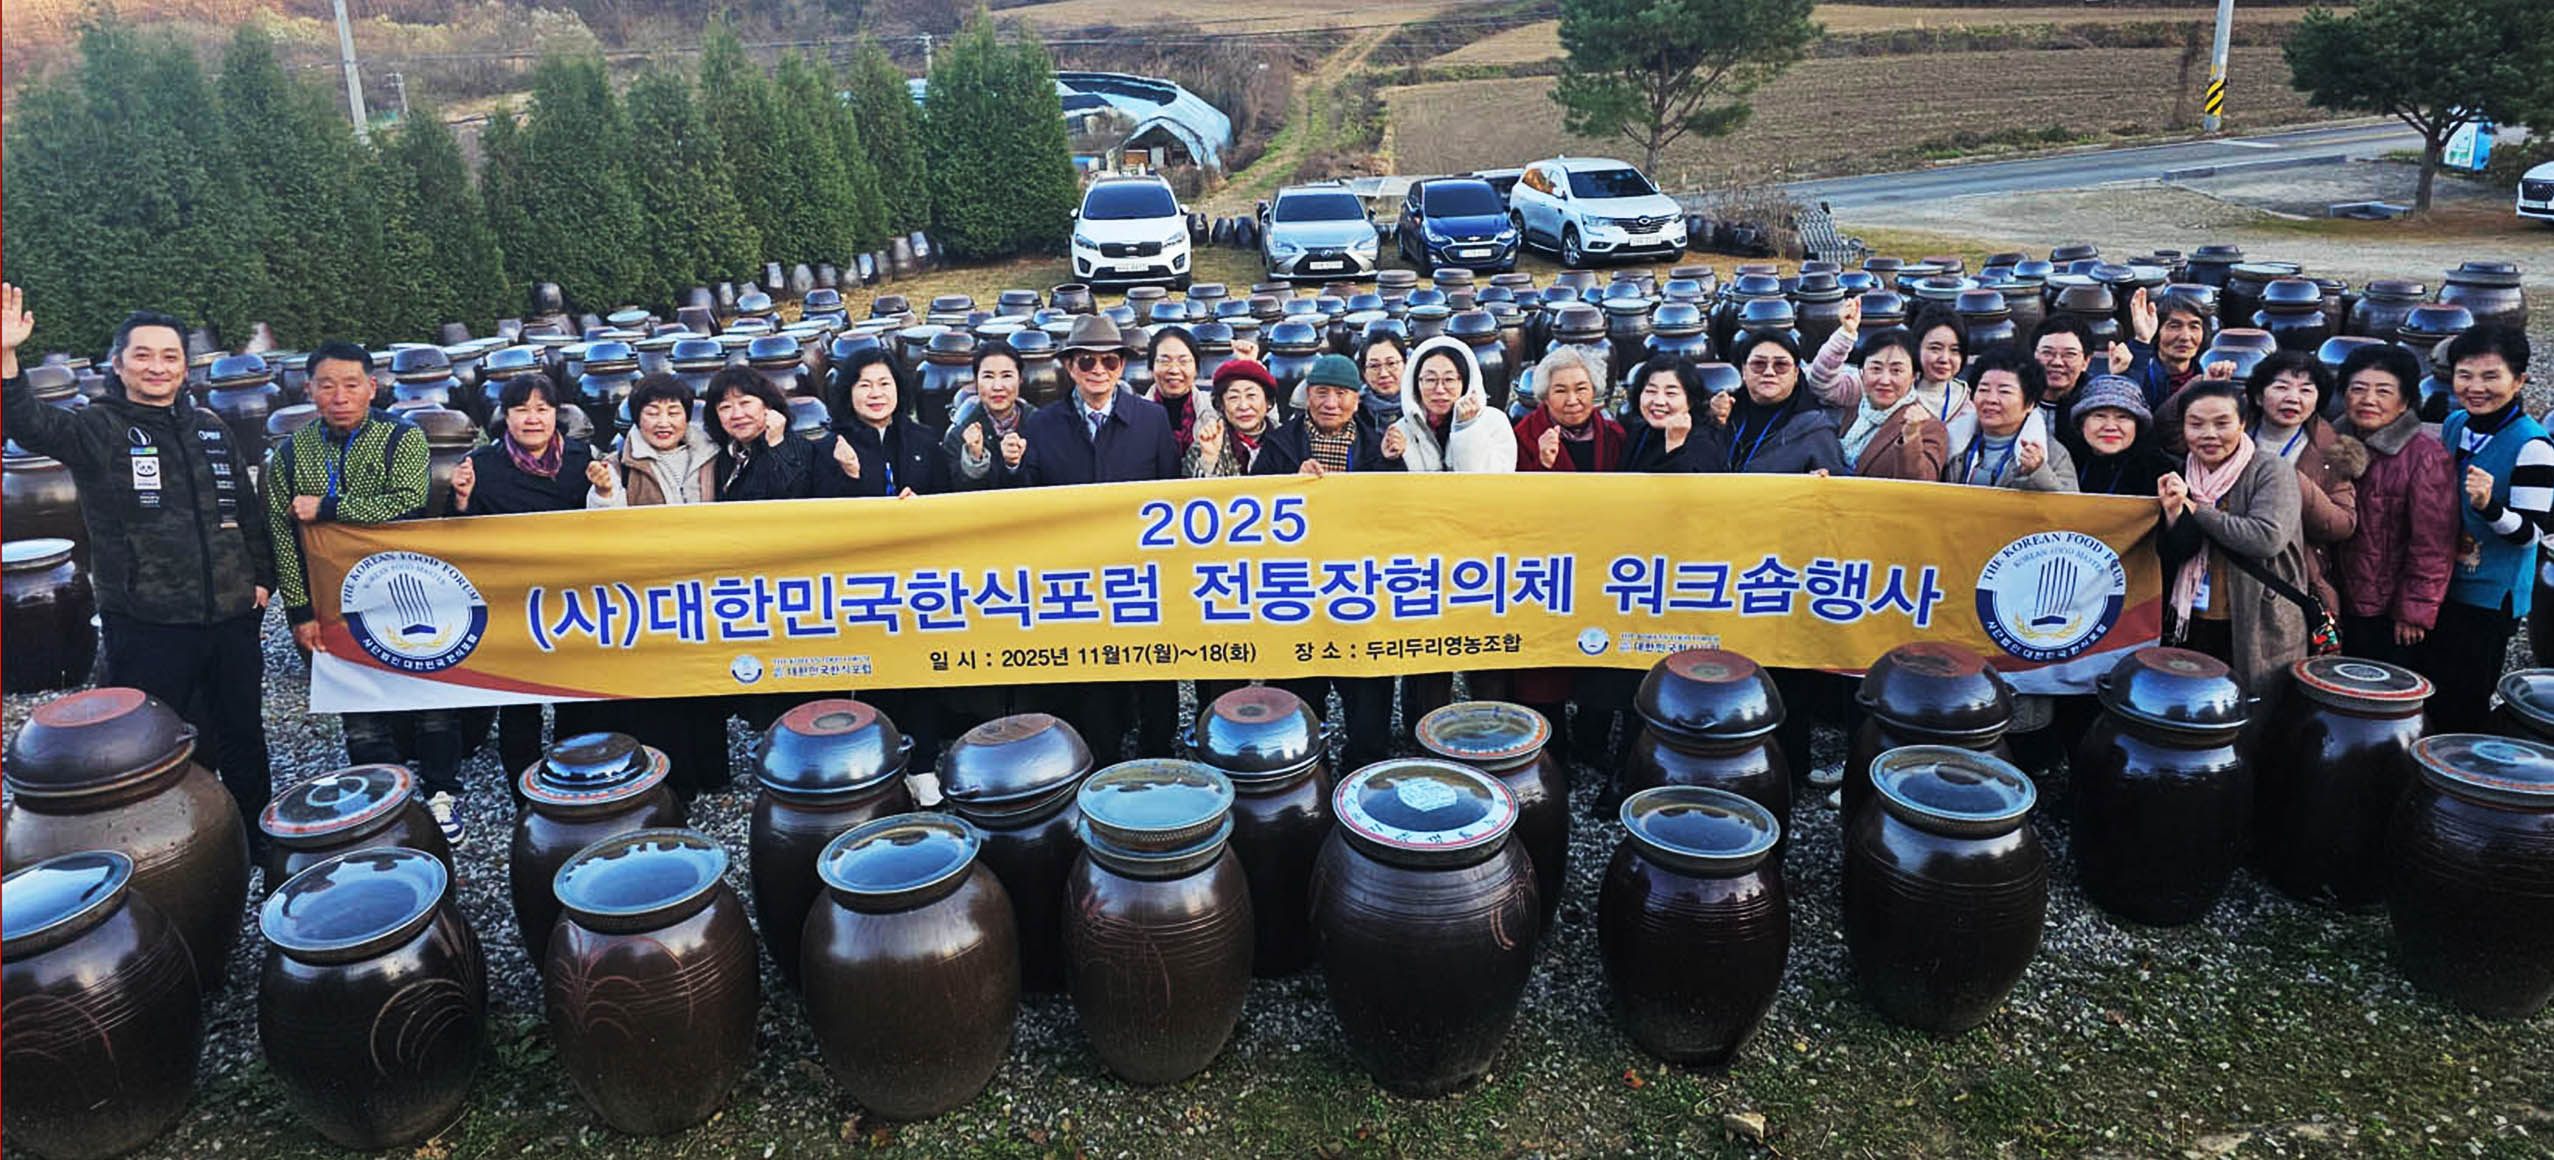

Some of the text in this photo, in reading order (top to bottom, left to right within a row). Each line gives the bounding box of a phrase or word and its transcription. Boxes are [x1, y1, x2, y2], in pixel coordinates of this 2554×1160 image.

[1141, 497, 1307, 547] 2025
[350, 553, 396, 582] KOREAN
[1983, 558, 2004, 581] THE
[2002, 533, 2061, 558] KOREAN
[2066, 533, 2103, 553] FOOD
[528, 555, 1943, 651] (사)대한민국한식포럼 전통장협의체 워크숍행사
[1001, 646, 1069, 667] 2025년
[1077, 642, 1257, 666] 11월17(월)~18(화)
[1365, 633, 1522, 660] 두리두리영농조합
